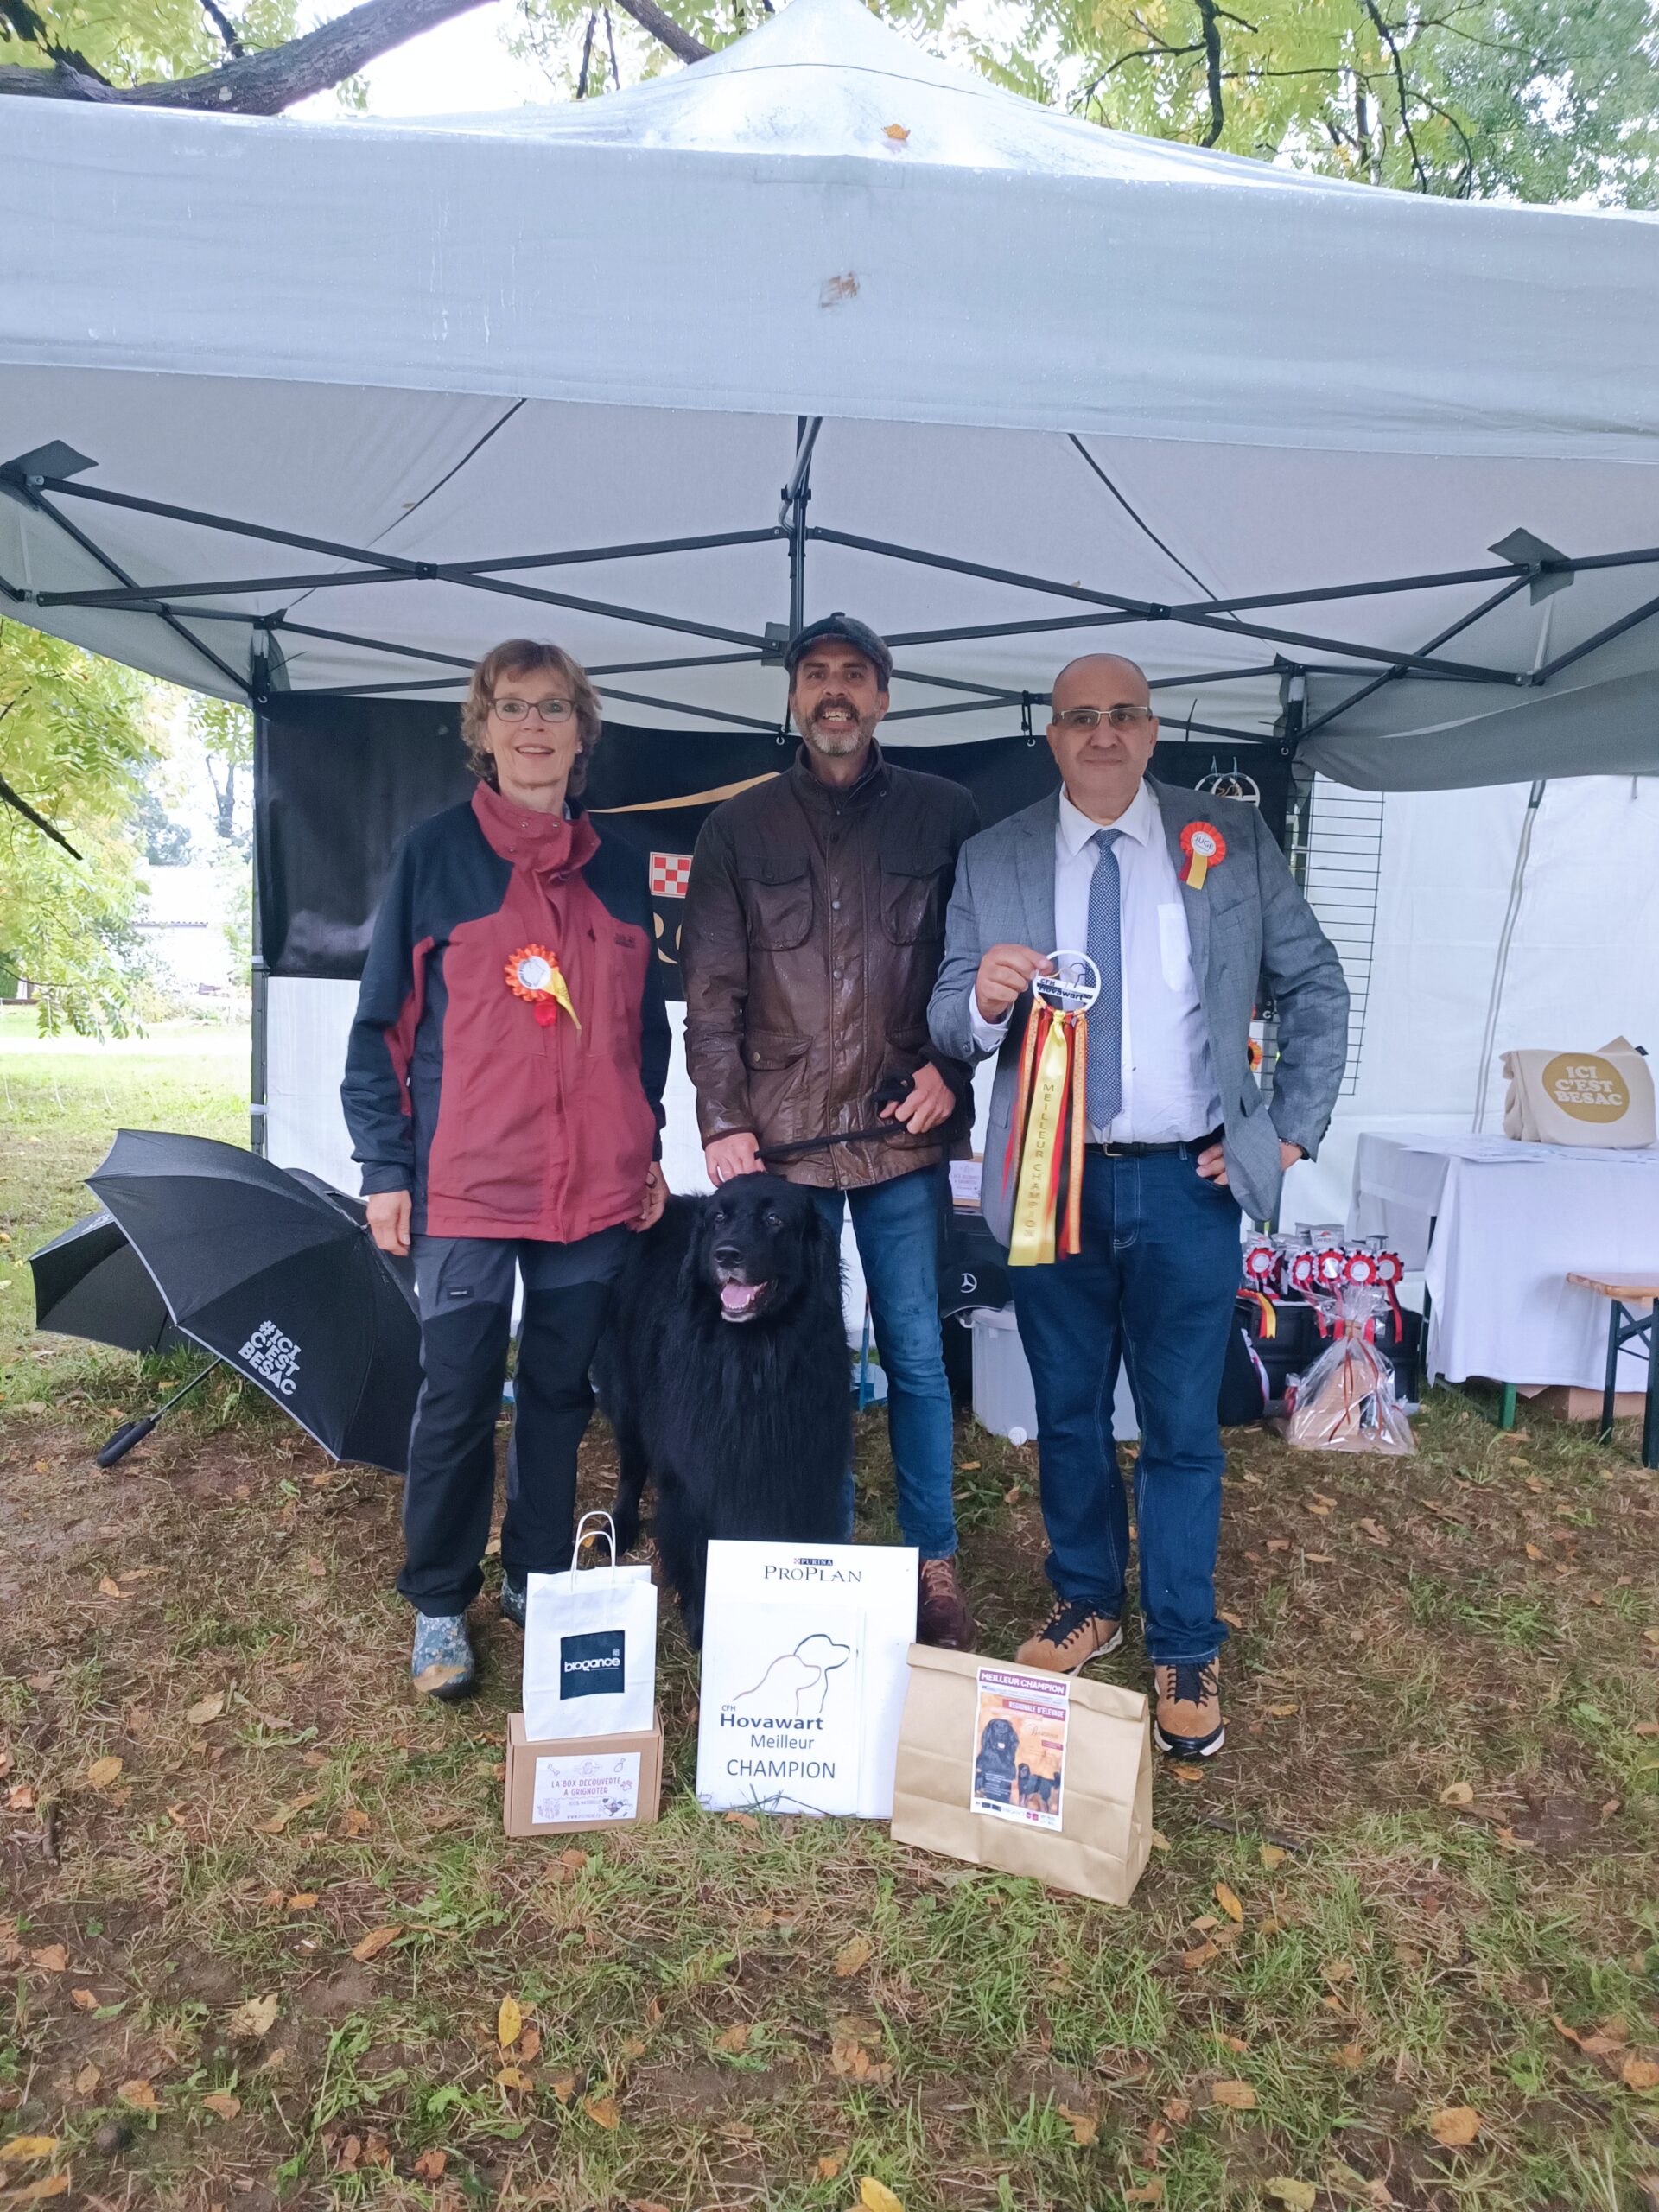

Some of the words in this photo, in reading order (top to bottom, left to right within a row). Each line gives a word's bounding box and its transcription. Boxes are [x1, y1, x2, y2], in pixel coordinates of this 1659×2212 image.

[1039, 978, 1056, 987] CFH
[1566, 1066, 1598, 1079] ICI
[1555, 1079, 1613, 1093] C'EST
[1554, 1090, 1624, 1107] BESAC
[1035, 1083, 1055, 1159] MEILLEUR
[259, 1320, 302, 1361] #ICI
[251, 1332, 301, 1376] C'EST
[238, 1341, 296, 1395] BESAC
[564, 1657, 621, 1673] biogance
[981, 1673, 1020, 1686] MEILLEUR
[1020, 1679, 1065, 1694] CHAMPION
[721, 1713, 823, 1731] Hovawart
[751, 1734, 815, 1749] Meilleur
[727, 1758, 836, 1778] CHAMPION
[571, 1787, 608, 1796] GRIGNOTER
